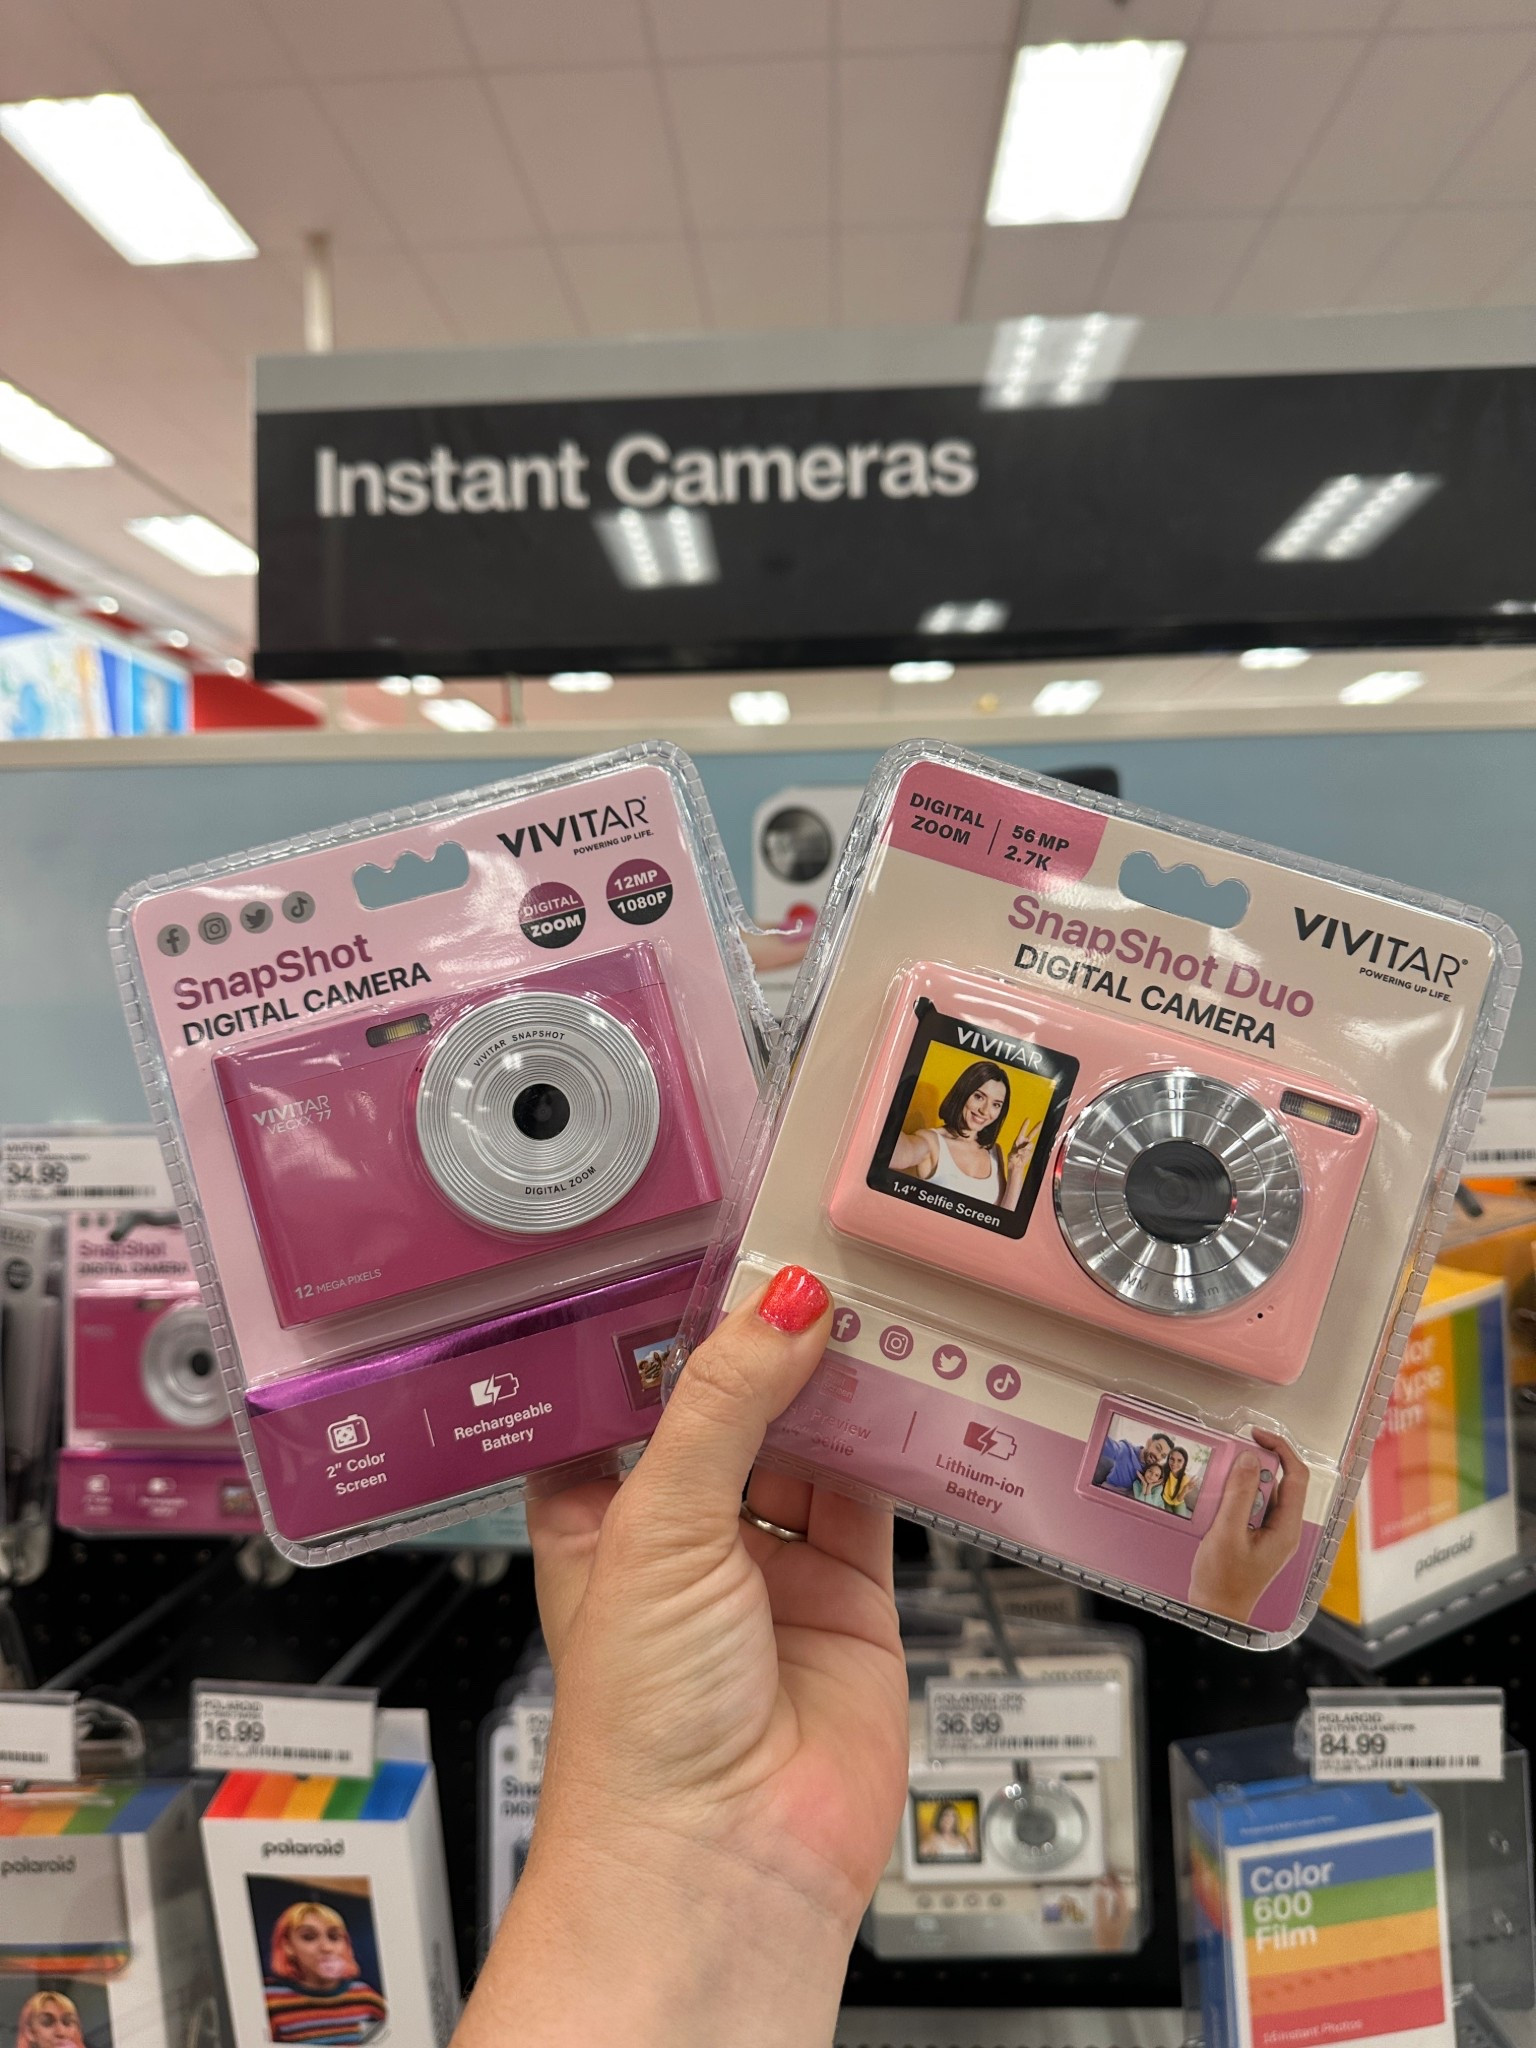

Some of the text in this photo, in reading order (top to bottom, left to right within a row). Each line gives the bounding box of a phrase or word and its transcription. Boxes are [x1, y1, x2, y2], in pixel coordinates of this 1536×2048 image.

[315, 428, 977, 518] Instant Cameras
[909, 792, 985, 829] DIGITAL
[573, 829, 655, 856] POWERING UP LIFE.
[910, 815, 971, 845] ZOOM
[1011, 825, 1070, 853] 56 MP
[1003, 845, 1052, 872] 2.7K
[613, 869, 659, 892] 12MP
[523, 895, 579, 918] DIGITAL
[617, 891, 668, 916] 1080P
[530, 913, 582, 938] ZOOM
[1007, 894, 1315, 1018] SnapShot Duo
[174, 934, 373, 1011] SnapShot
[1359, 966, 1452, 1003] POWERING UP LIFE.
[182, 962, 432, 1047] DIGITAL CAMERA
[1014, 943, 1276, 1050] DIGITAL CAMERA
[474, 1030, 566, 1067] VIVITAR SNAPSHOT
[957, 1026, 1043, 1070] VIVITAR
[252, 1095, 331, 1127] VIVITAR
[6, 1161, 69, 1184] 34.99
[525, 1166, 597, 1196] DIGITAL ZOOM
[893, 1181, 1001, 1228] 1.4" Selfie Screen
[295, 1268, 382, 1299] 12 MEGA PIXELS
[453, 1399, 553, 1442] Rechargeable
[811, 1408, 872, 1440] Preview
[481, 1425, 535, 1454] Battery
[811, 1431, 855, 1457] Selfie
[345, 1450, 386, 1474] Color
[935, 1452, 1025, 1498] Lithium-ion
[335, 1471, 388, 1497] Screen
[945, 1479, 1004, 1515] Battery
[1415, 1530, 1474, 1582] polaroid
[204, 1719, 265, 1742] 16.99
[936, 1711, 1003, 1735] 36.99
[1319, 1732, 1387, 1756] 84.99
[262, 1839, 346, 1859] polaroid
[1, 1855, 77, 1878] polaroid
[1250, 1861, 1335, 1894] Color
[1253, 1890, 1313, 1923] 600
[1255, 1922, 1318, 1954] Film
